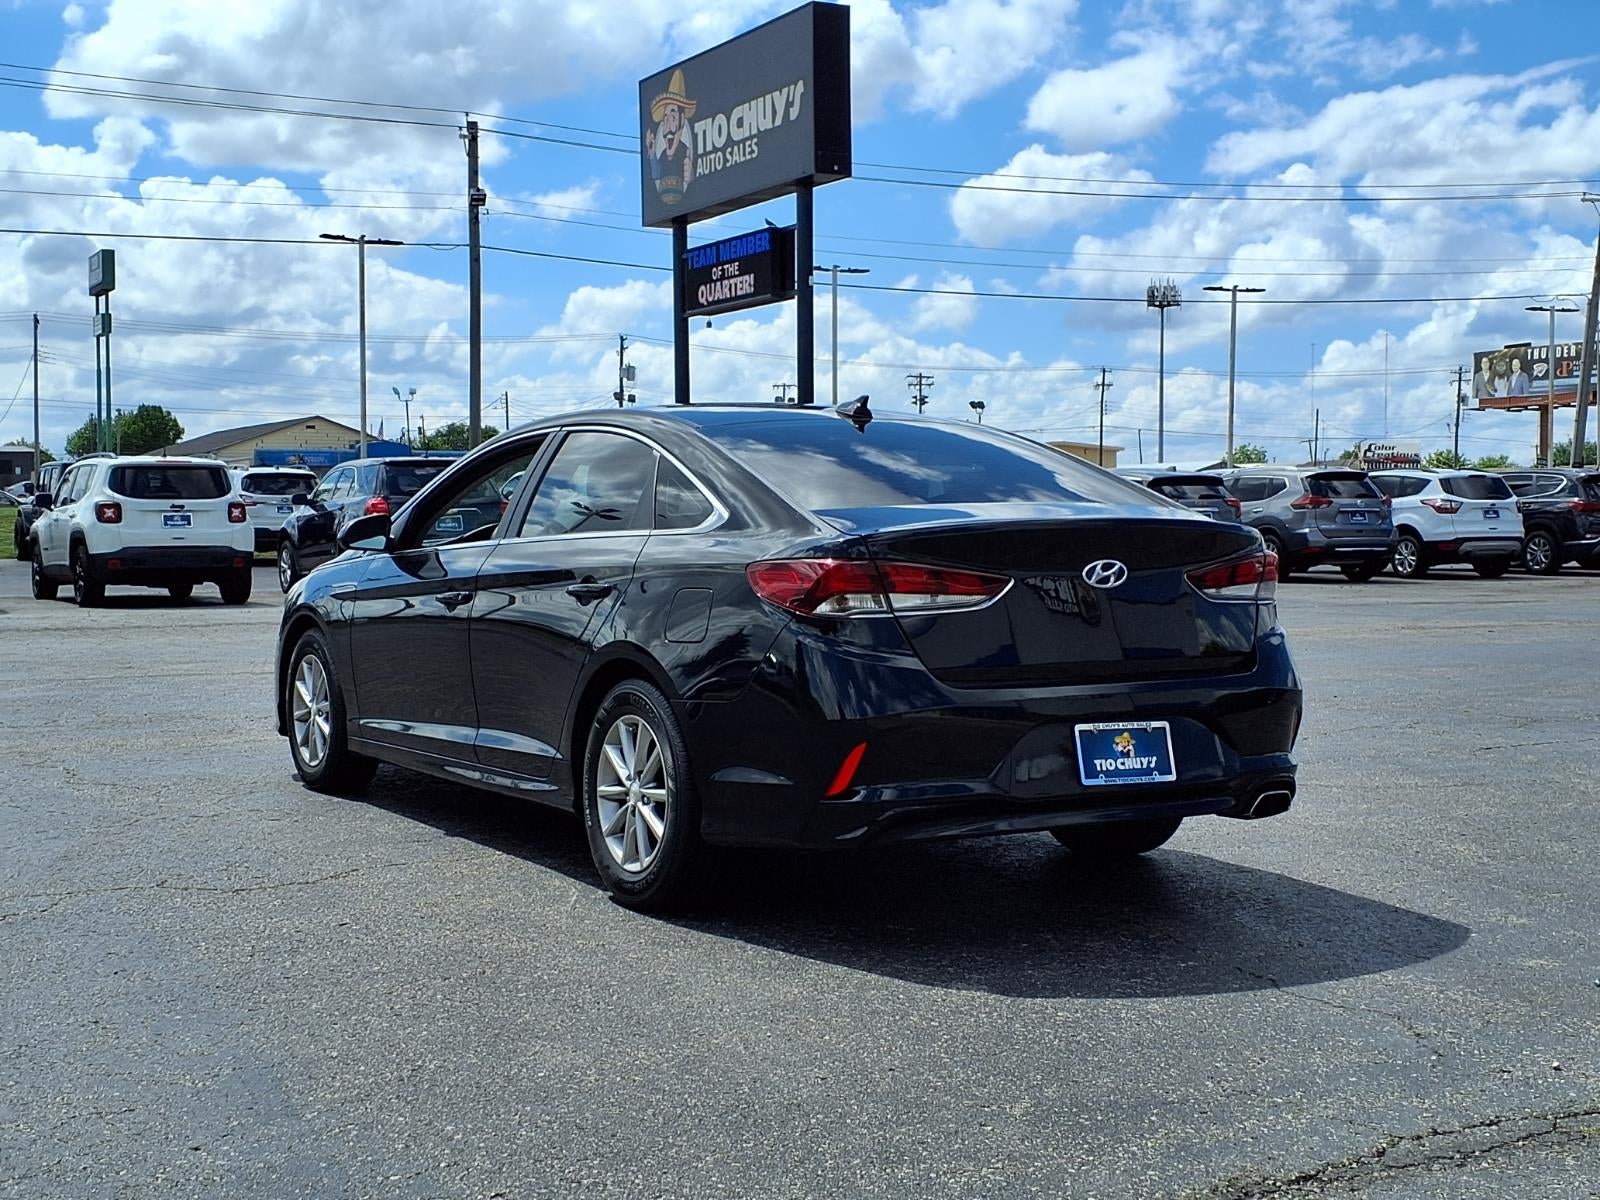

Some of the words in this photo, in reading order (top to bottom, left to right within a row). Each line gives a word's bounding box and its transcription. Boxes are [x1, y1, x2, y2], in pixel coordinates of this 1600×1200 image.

[694, 113, 728, 154] TIO
[729, 79, 805, 142] CHUY'S
[696, 151, 724, 178] AUTO
[725, 138, 759, 168] SALES
[687, 245, 716, 270] TEAM
[720, 231, 770, 261] MEMBER
[711, 267, 722, 281] OF
[723, 262, 740, 277] THE
[697, 272, 755, 306] QUARTER!
[1527, 345, 1576, 361] THUDER
[1367, 442, 1397, 453] Color
[1094, 758, 1116, 771] TIO
[1116, 756, 1157, 770] CHUY'S
